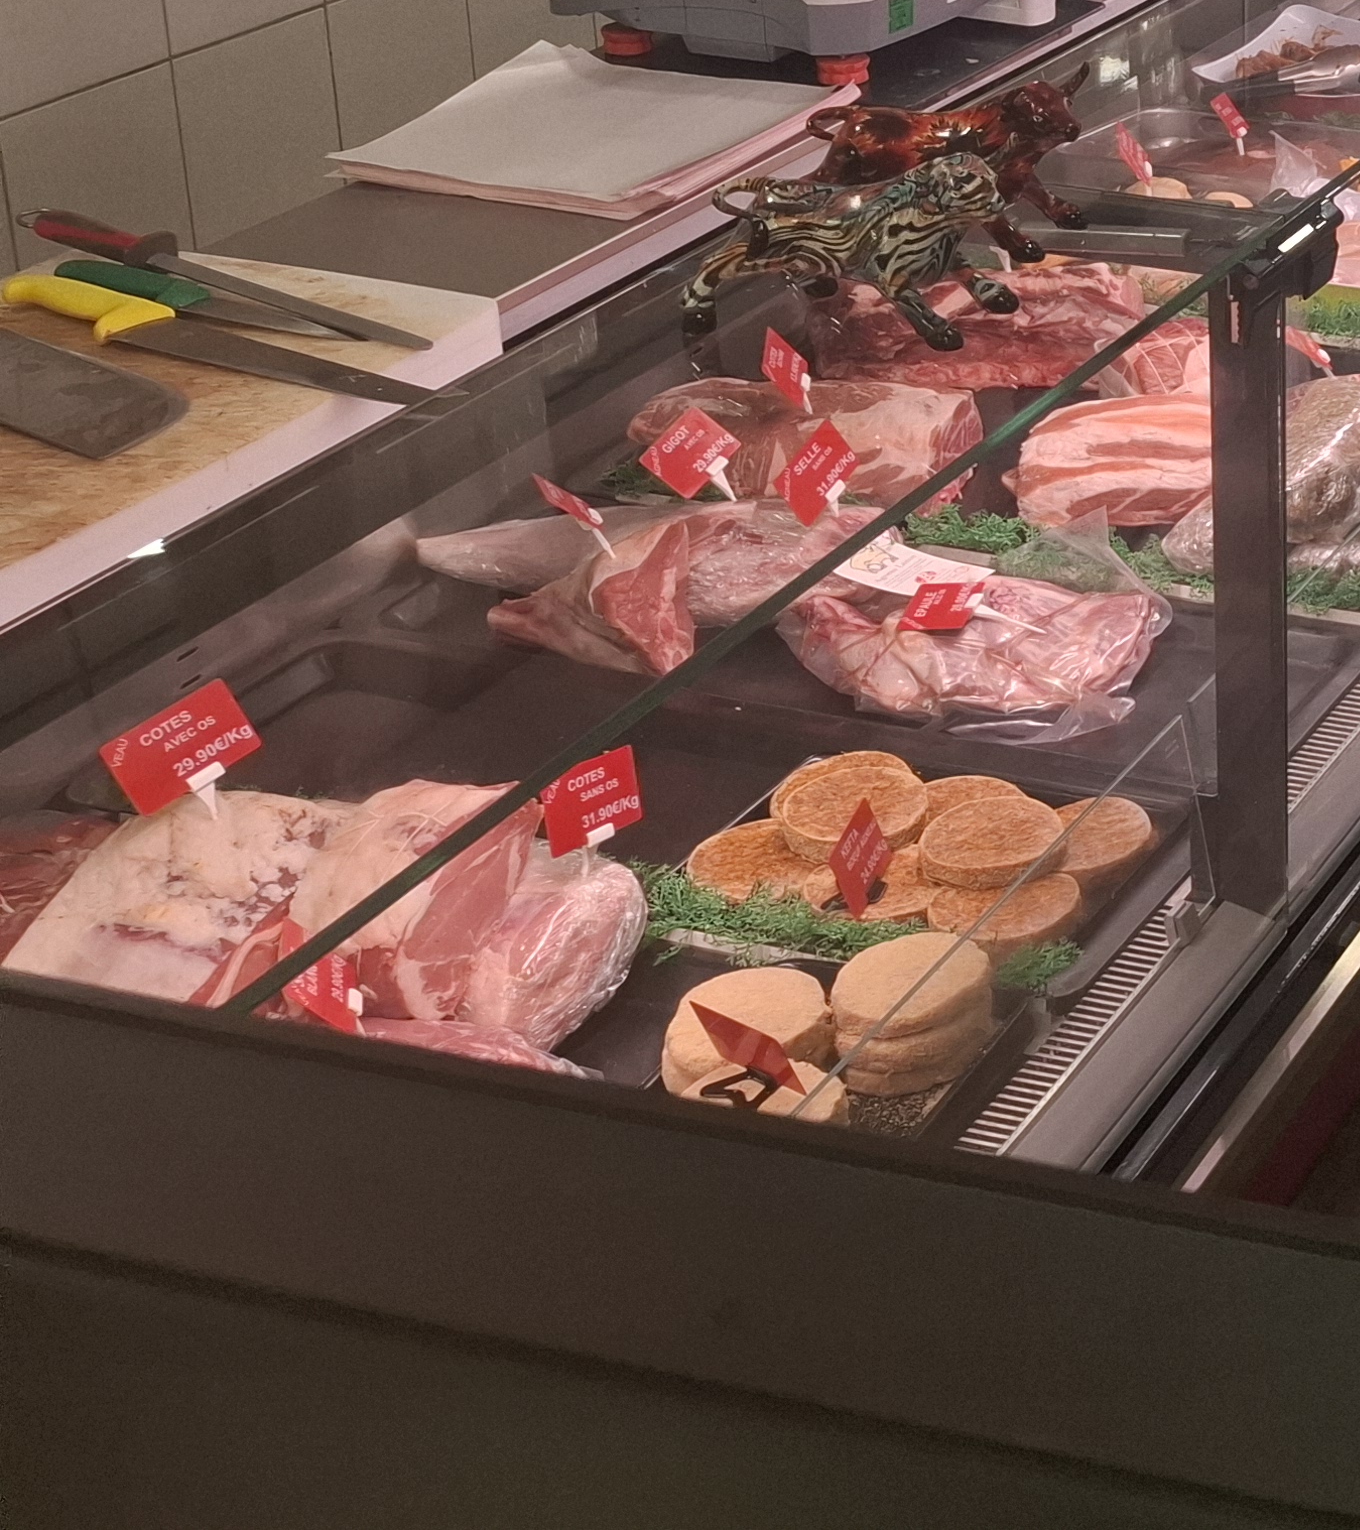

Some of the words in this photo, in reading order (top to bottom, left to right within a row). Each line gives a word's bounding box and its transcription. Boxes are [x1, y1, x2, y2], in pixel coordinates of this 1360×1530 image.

[662, 425, 690, 454] GIGOT
[692, 433, 735, 474] 29.90€/Kg
[793, 442, 822, 476] SELLE
[816, 451, 856, 497] 31.90€/Kg
[139, 710, 193, 747] COTES
[163, 727, 198, 753] AVEC
[197, 715, 216, 731] OS
[111, 738, 129, 768] VEAU
[172, 724, 254, 778] 29.90€/Kg
[567, 766, 606, 792] COTES
[580, 784, 606, 802] SANS
[605, 778, 620, 791] OS
[581, 795, 640, 829] 31.90€/Kg
[840, 828, 860, 859] KEFTA
